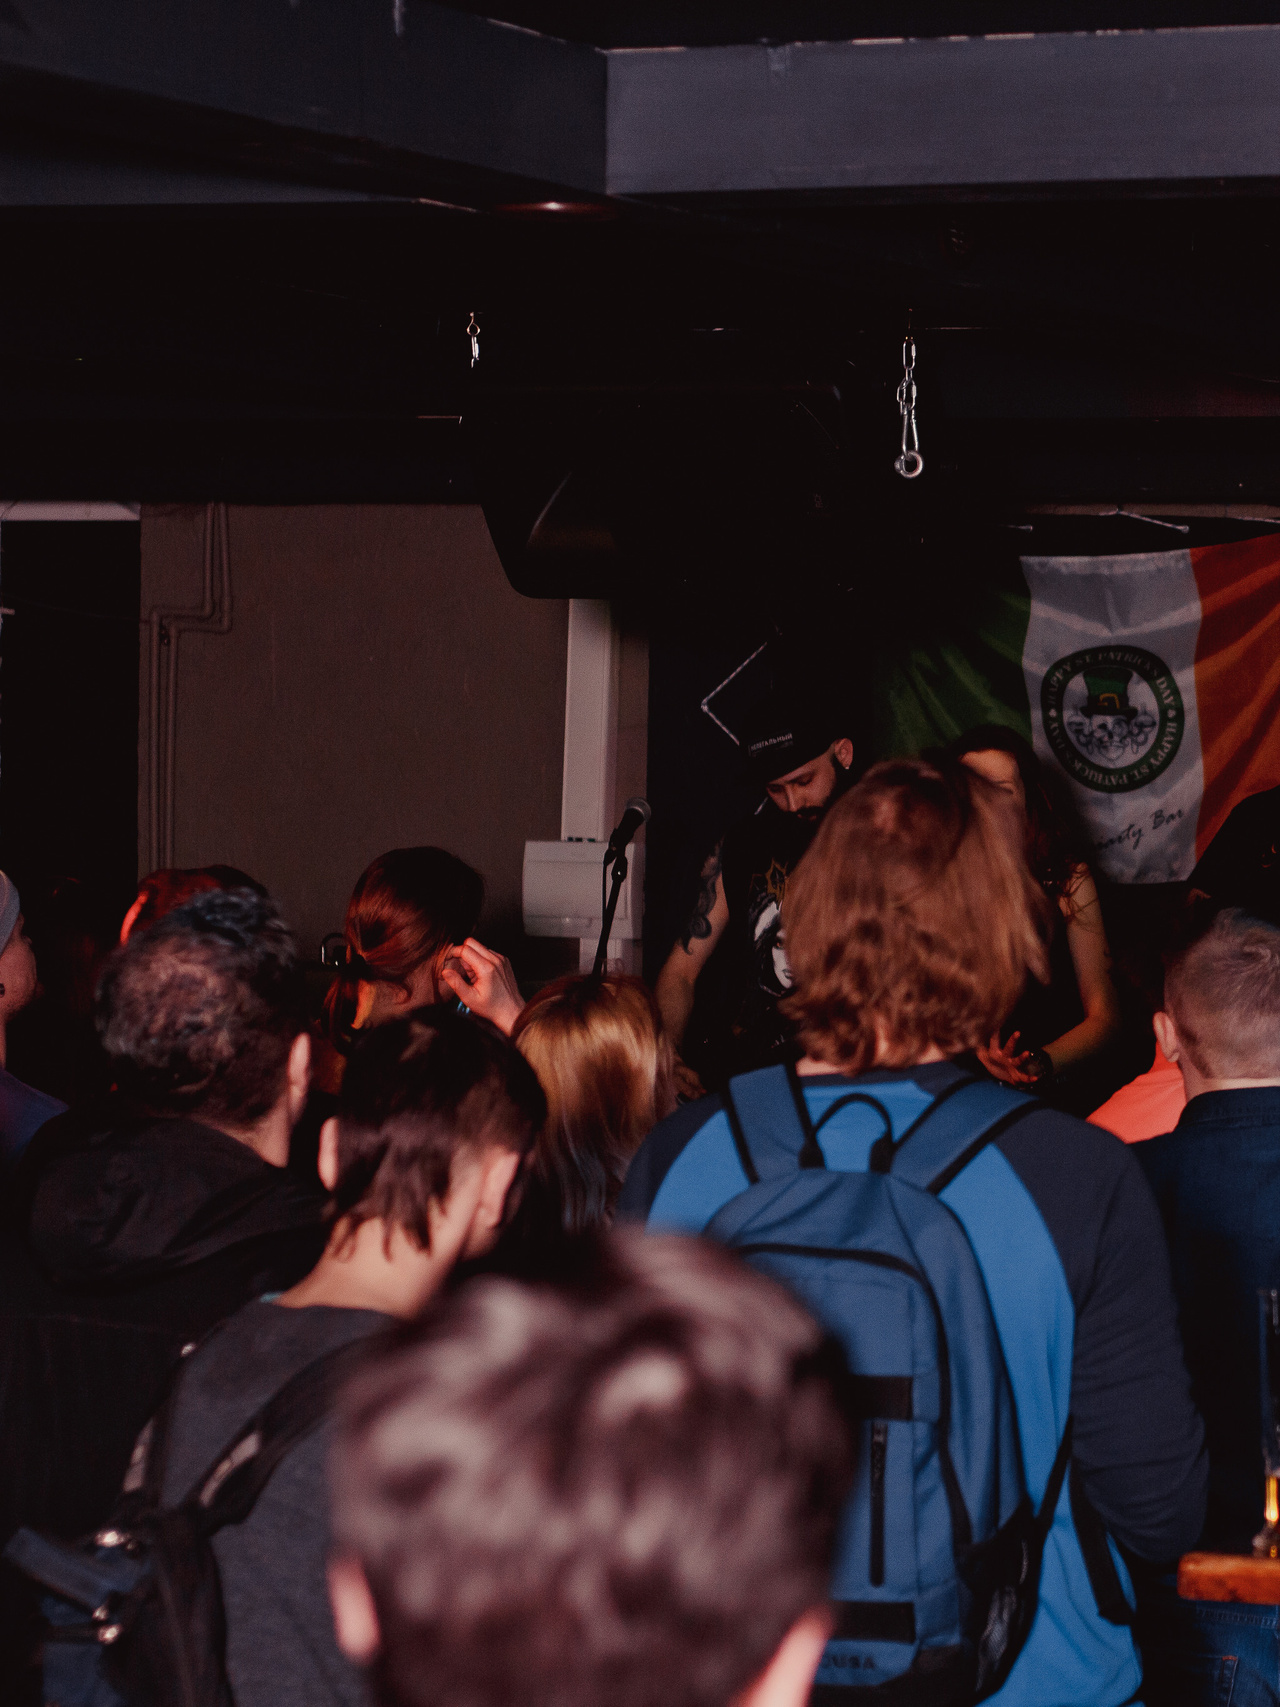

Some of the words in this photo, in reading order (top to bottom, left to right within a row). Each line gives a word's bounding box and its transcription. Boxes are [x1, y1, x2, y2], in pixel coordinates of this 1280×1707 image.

[1047, 661, 1073, 706] HAPPY
[1155, 675, 1176, 706] DAY
[750, 733, 793, 751] НЕЛЕГАЛЬНЫЙ
[1048, 721, 1065, 750] DAY
[1149, 721, 1178, 767] HAPPY
[1150, 808, 1185, 830] Bar
